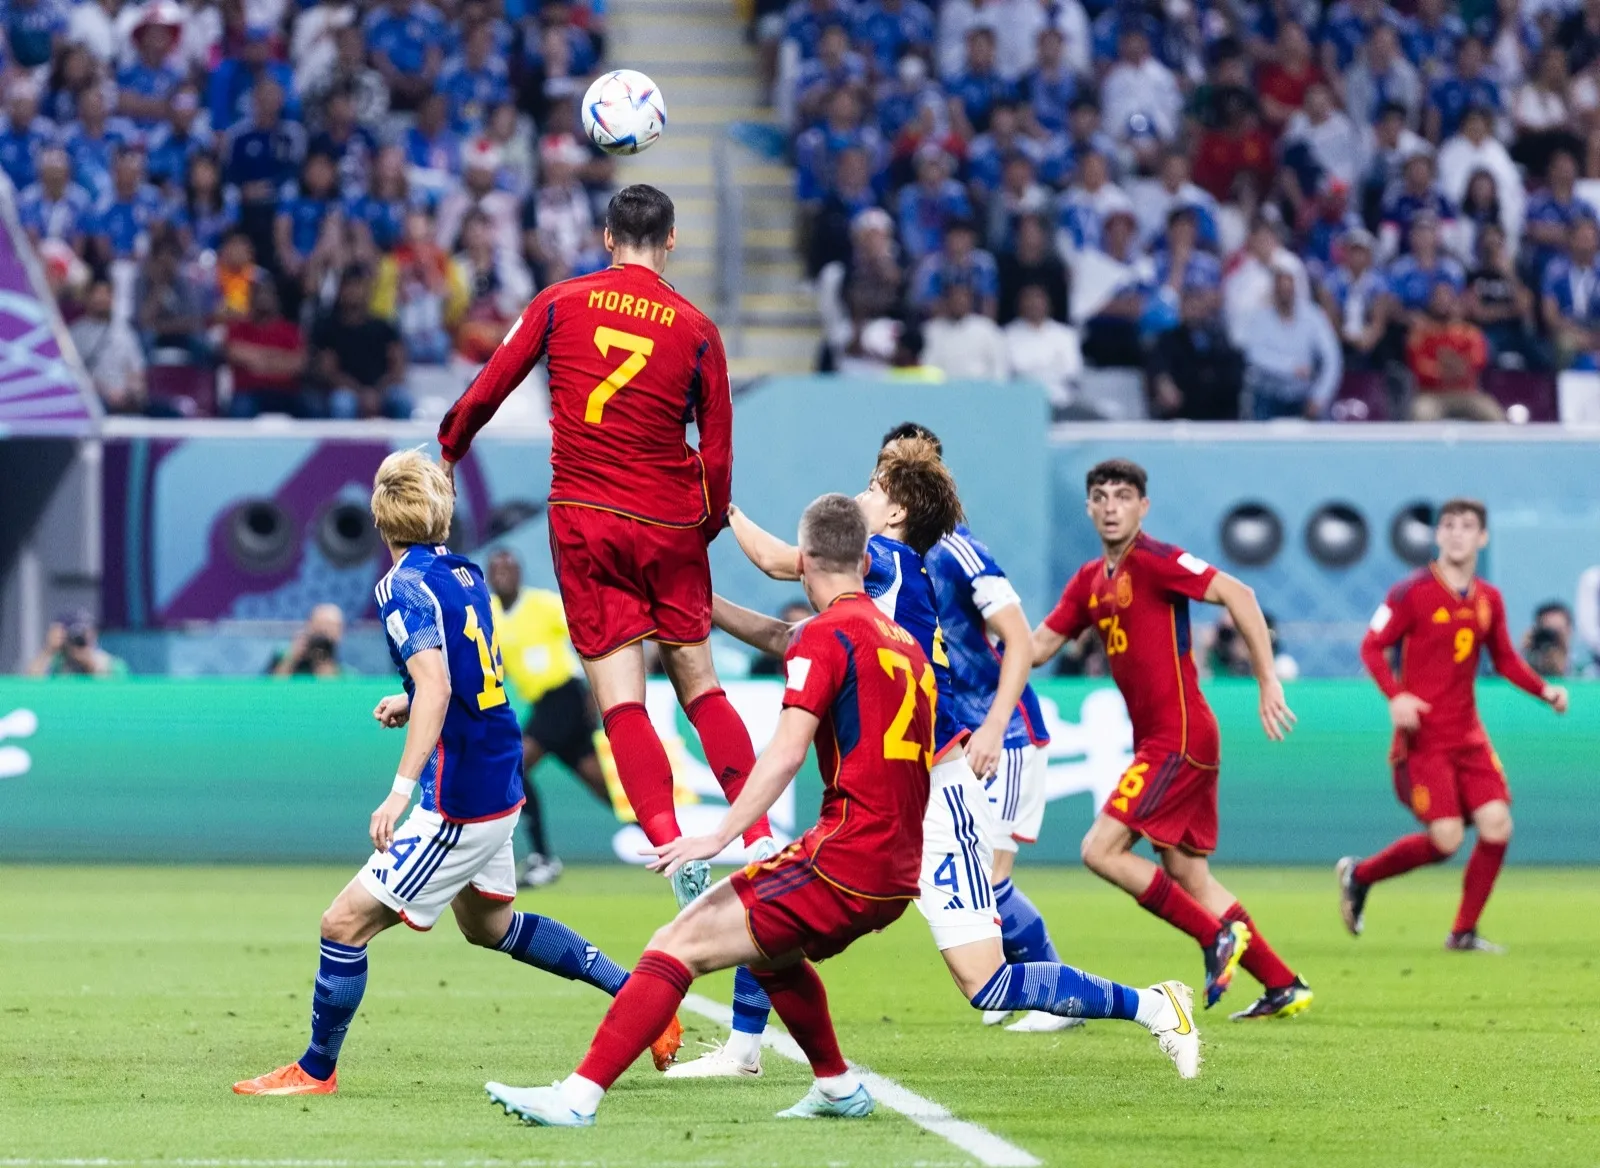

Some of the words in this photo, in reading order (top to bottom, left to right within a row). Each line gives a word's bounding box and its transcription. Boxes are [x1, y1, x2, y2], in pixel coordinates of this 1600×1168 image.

[588, 290, 677, 328] MORATA
[584, 326, 655, 425] 7
[1099, 615, 1128, 656] 26
[1454, 627, 1475, 664] 9
[876, 647, 938, 773] 21
[933, 852, 960, 893] 4
